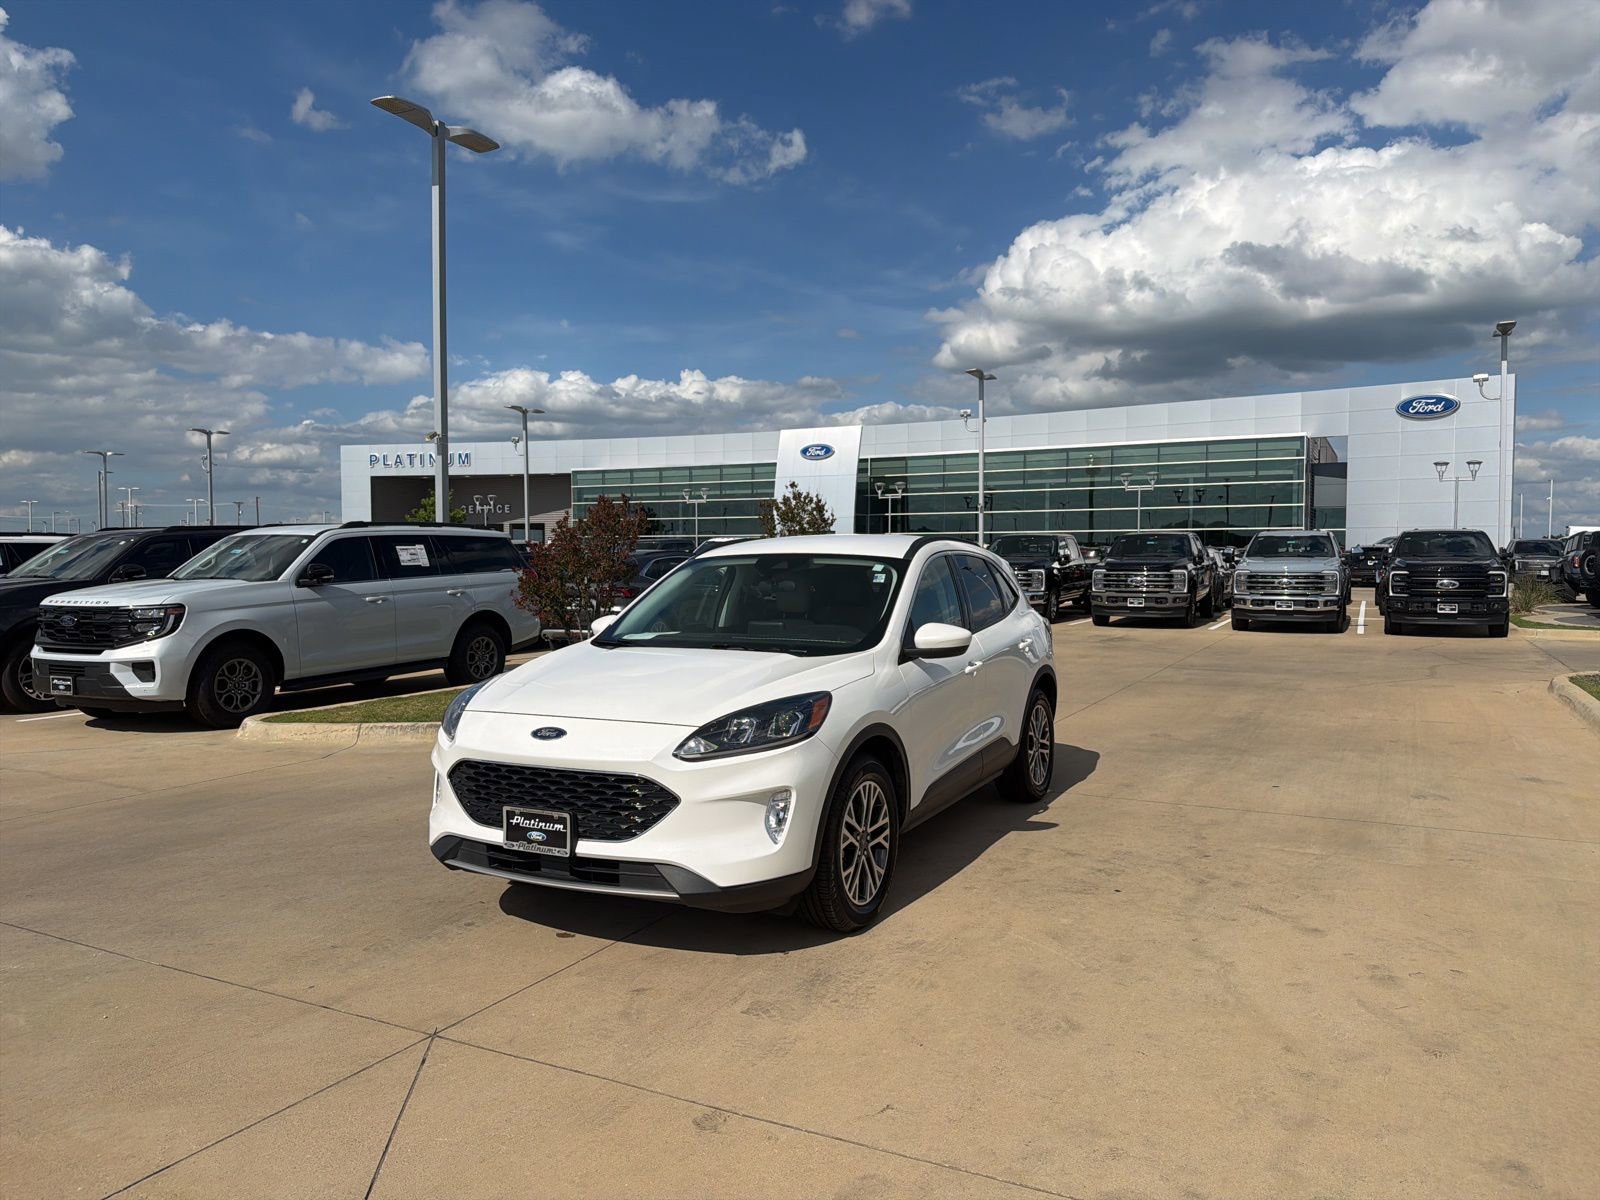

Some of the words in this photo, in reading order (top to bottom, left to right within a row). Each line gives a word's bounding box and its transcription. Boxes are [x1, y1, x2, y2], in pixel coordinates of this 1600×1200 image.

[1408, 399, 1445, 414] Ford
[509, 815, 567, 832] Platinum
[517, 841, 553, 855] Platinum
